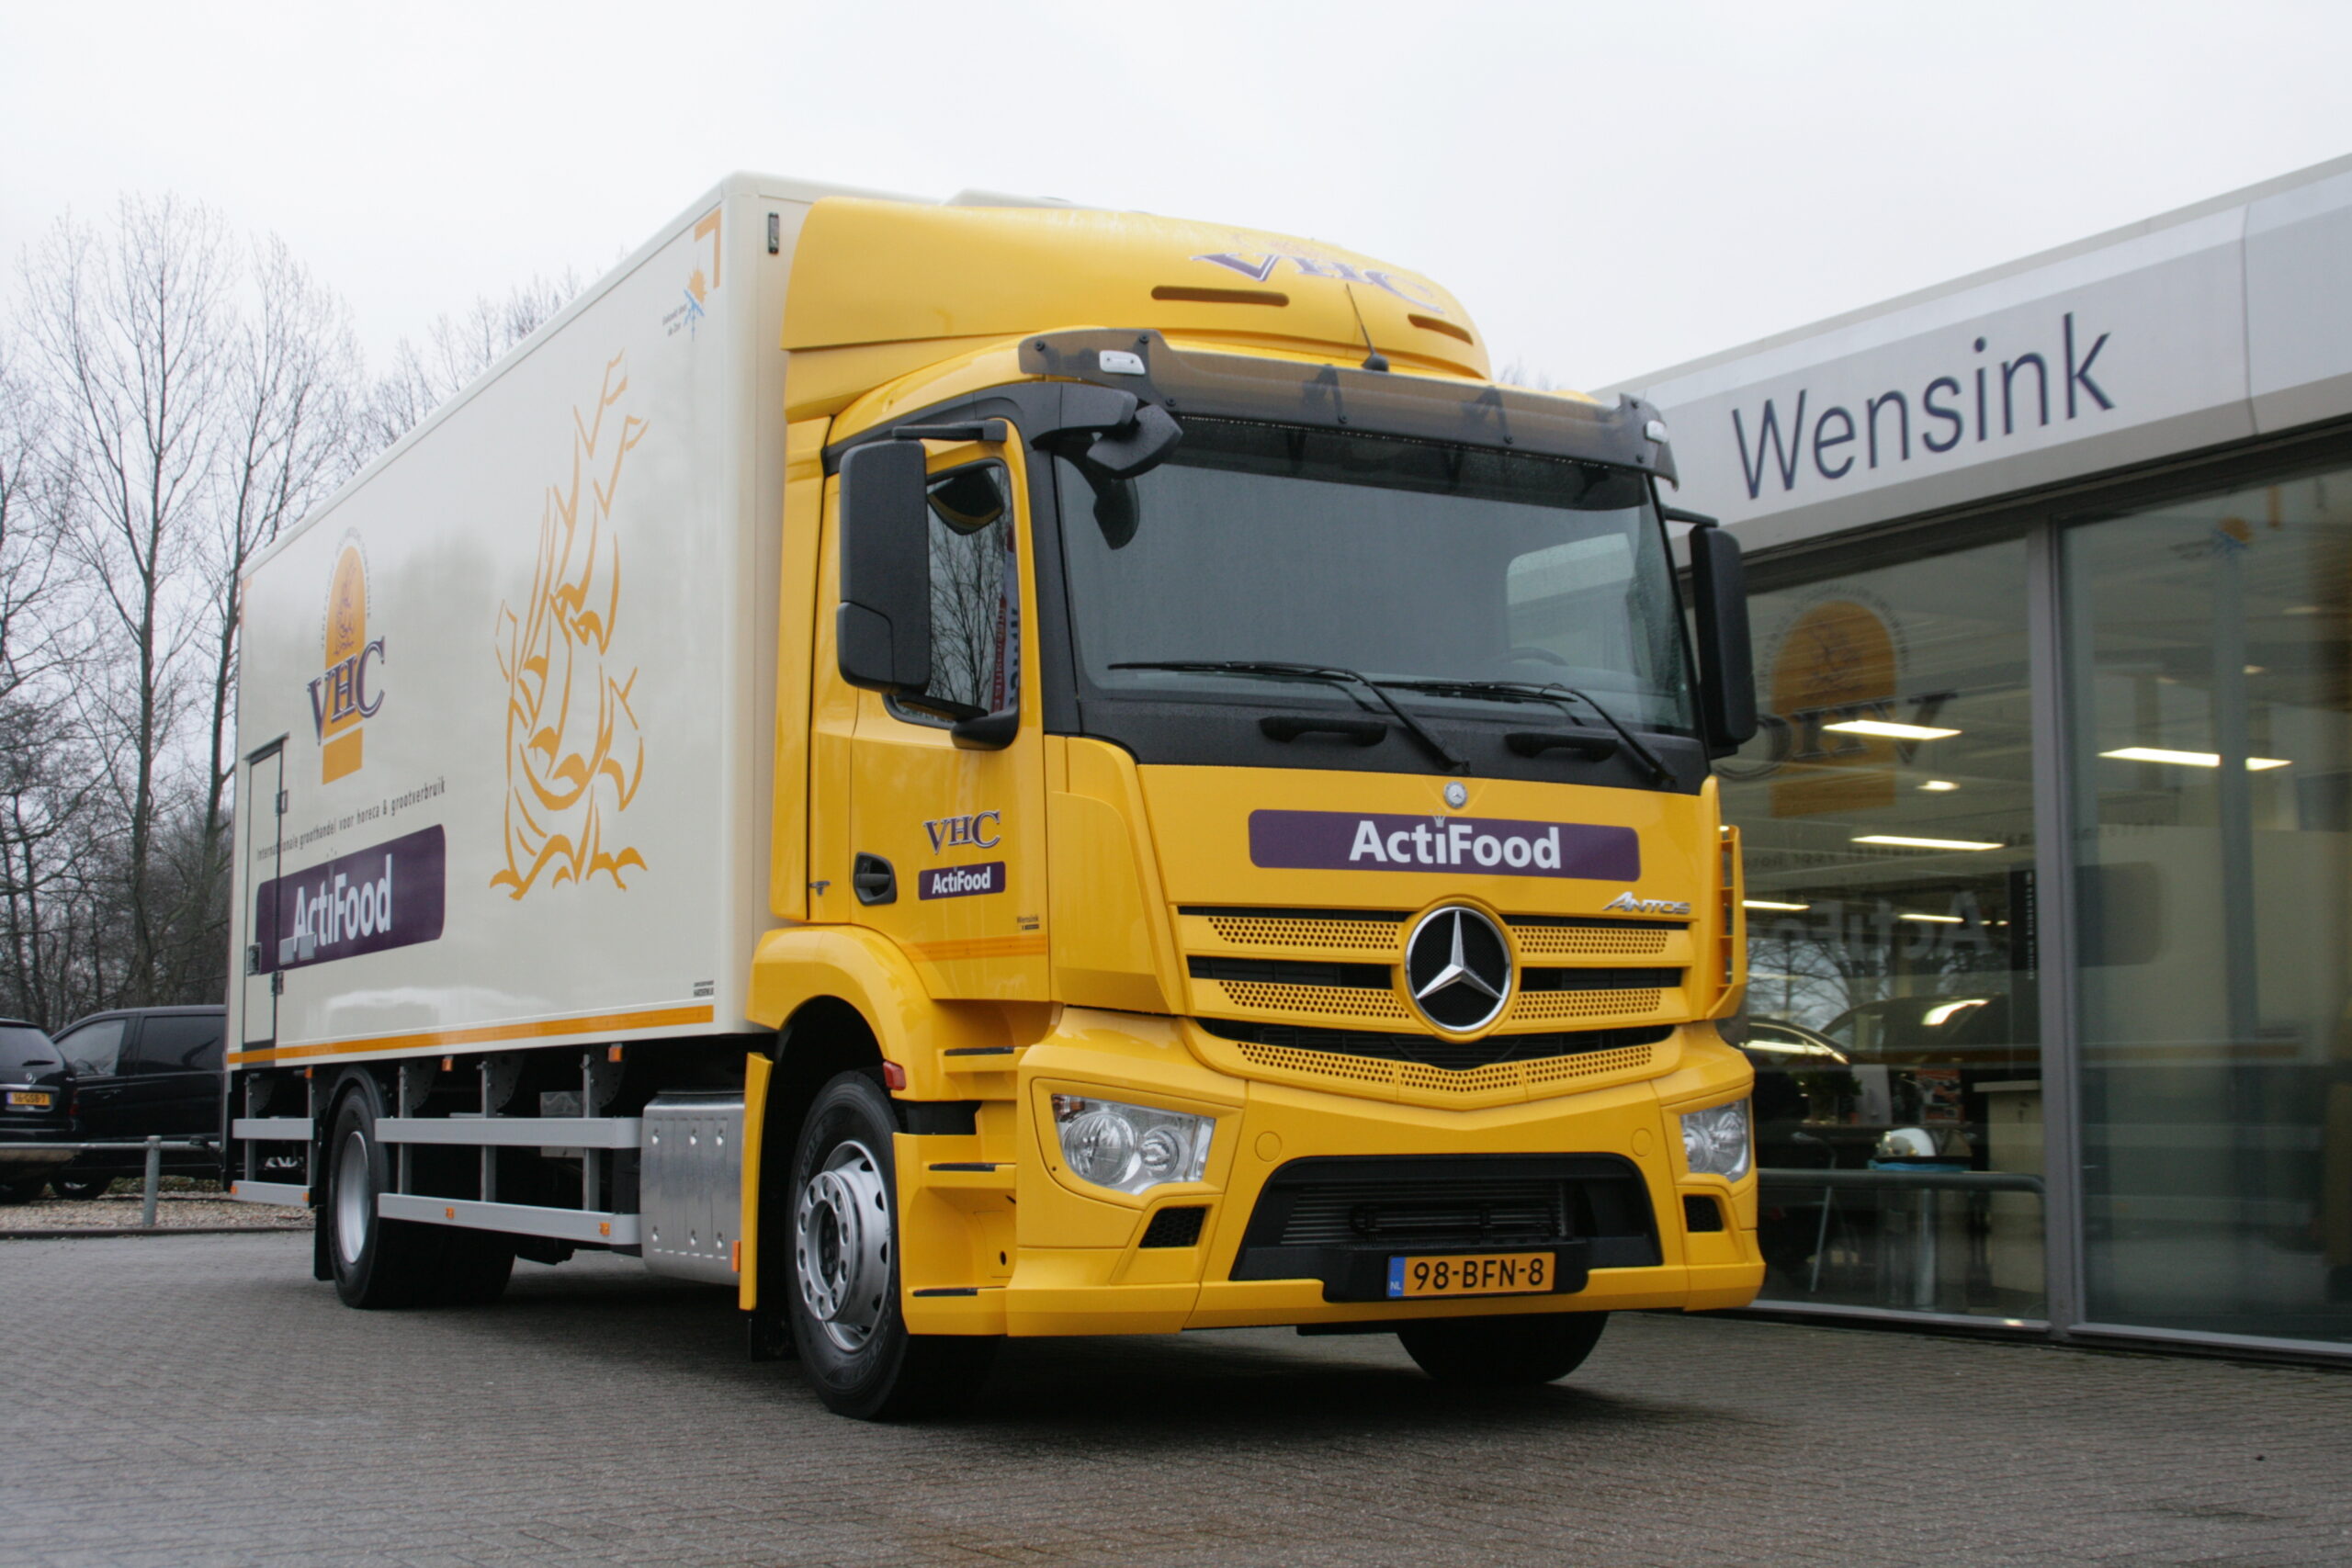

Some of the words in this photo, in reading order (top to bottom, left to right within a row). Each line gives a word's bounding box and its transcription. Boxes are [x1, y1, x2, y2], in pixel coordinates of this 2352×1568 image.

[1190, 252, 1445, 314] VHC
[1732, 311, 2116, 501] Wensink
[307, 636, 385, 747] VHC
[300, 818, 336, 850] groothandel
[339, 815, 354, 831] voor
[356, 805, 380, 824] horeca
[382, 798, 388, 816] &
[390, 776, 446, 817] grootverbruik
[922, 810, 1001, 856] VHC
[1349, 819, 1562, 870] ActiFood
[294, 852, 392, 953] ActiFood
[932, 865, 991, 895] ActiFood
[1389, 1280, 1402, 1292] NL
[1413, 1258, 1544, 1291] 98-BFN-8
